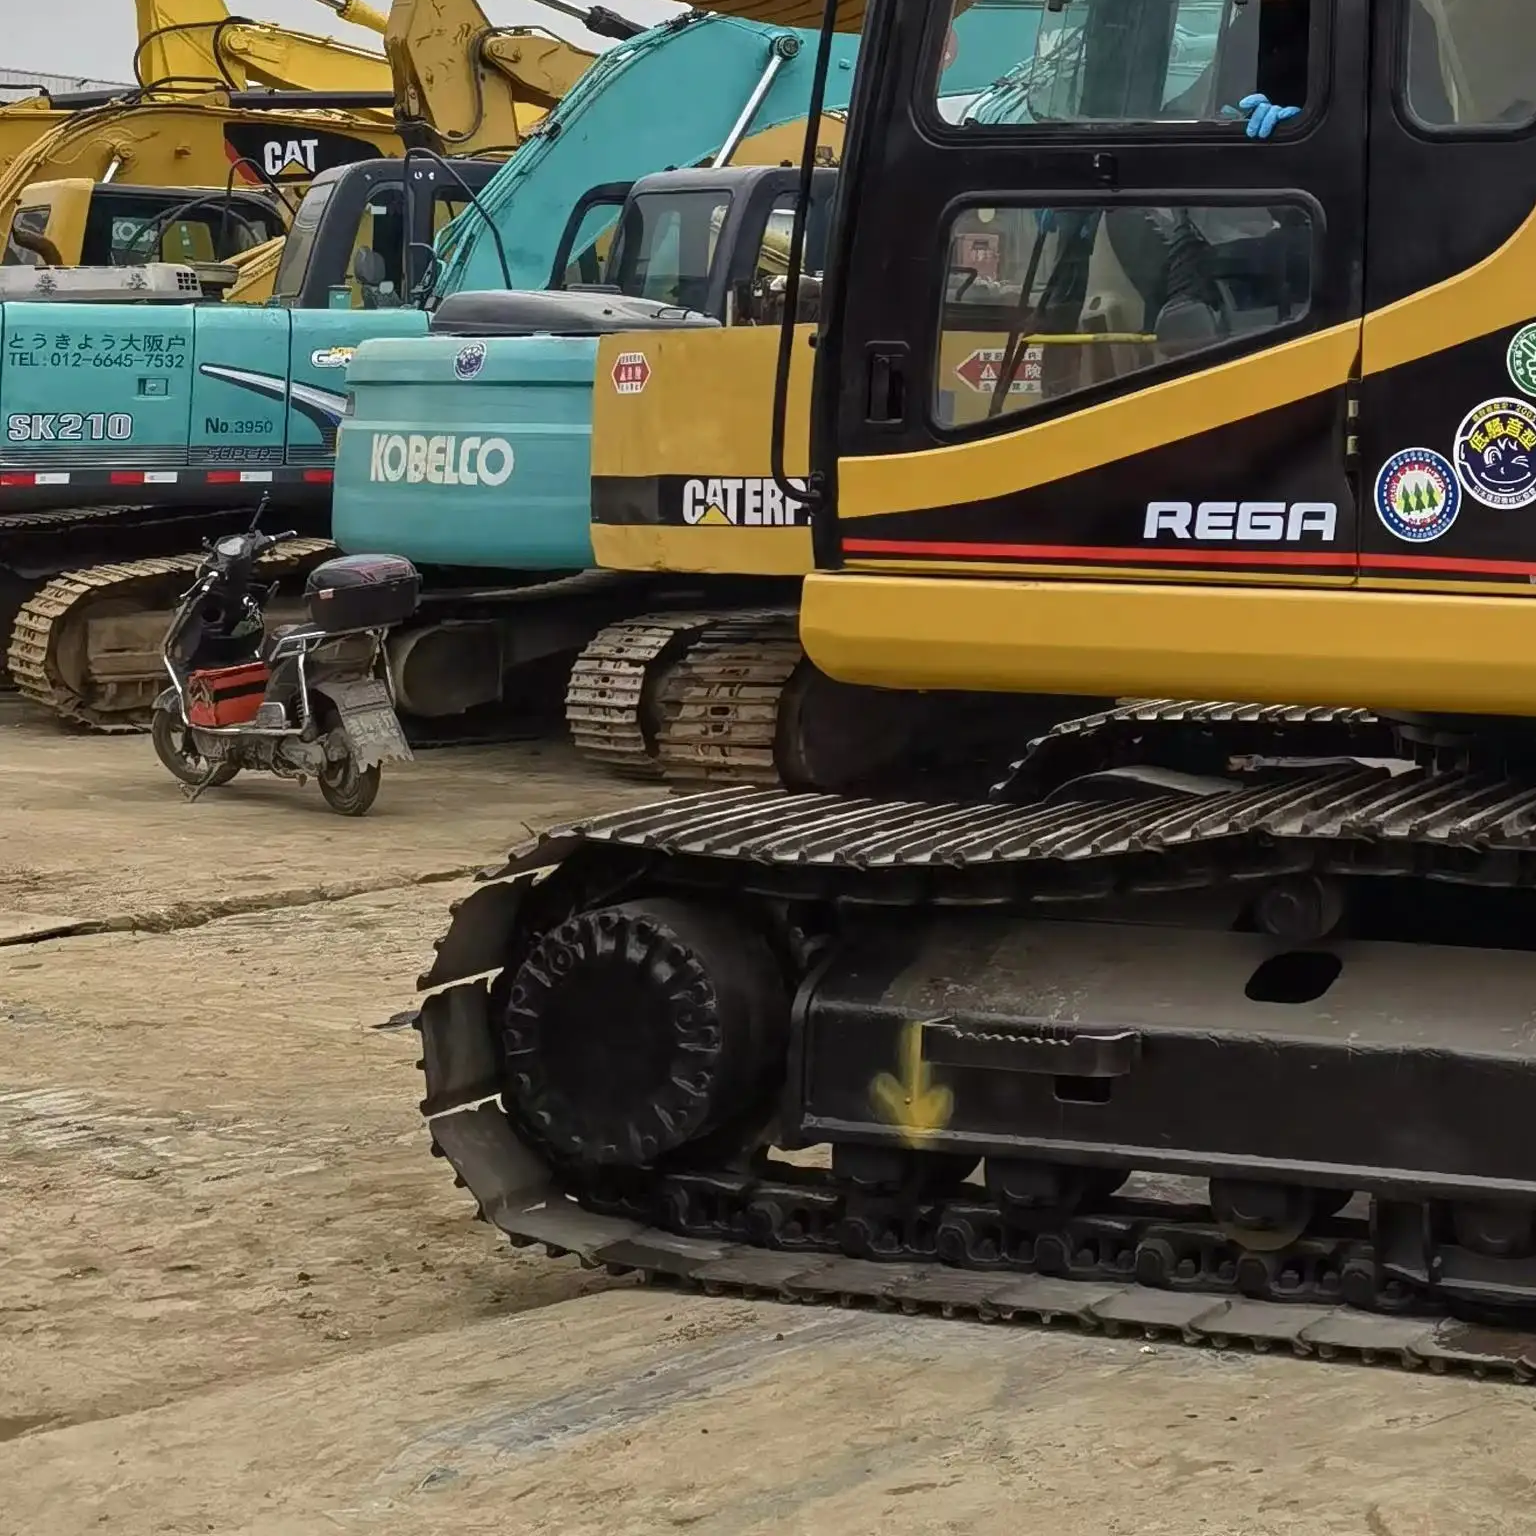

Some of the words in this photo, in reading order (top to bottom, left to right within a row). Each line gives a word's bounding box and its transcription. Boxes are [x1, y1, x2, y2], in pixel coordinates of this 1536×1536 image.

[263, 139, 319, 176] CAT
[7, 413, 133, 441] SK210
[369, 433, 515, 486] KOBELCO
[682, 478, 812, 525] CATERP
[1142, 501, 1337, 541] REGA
